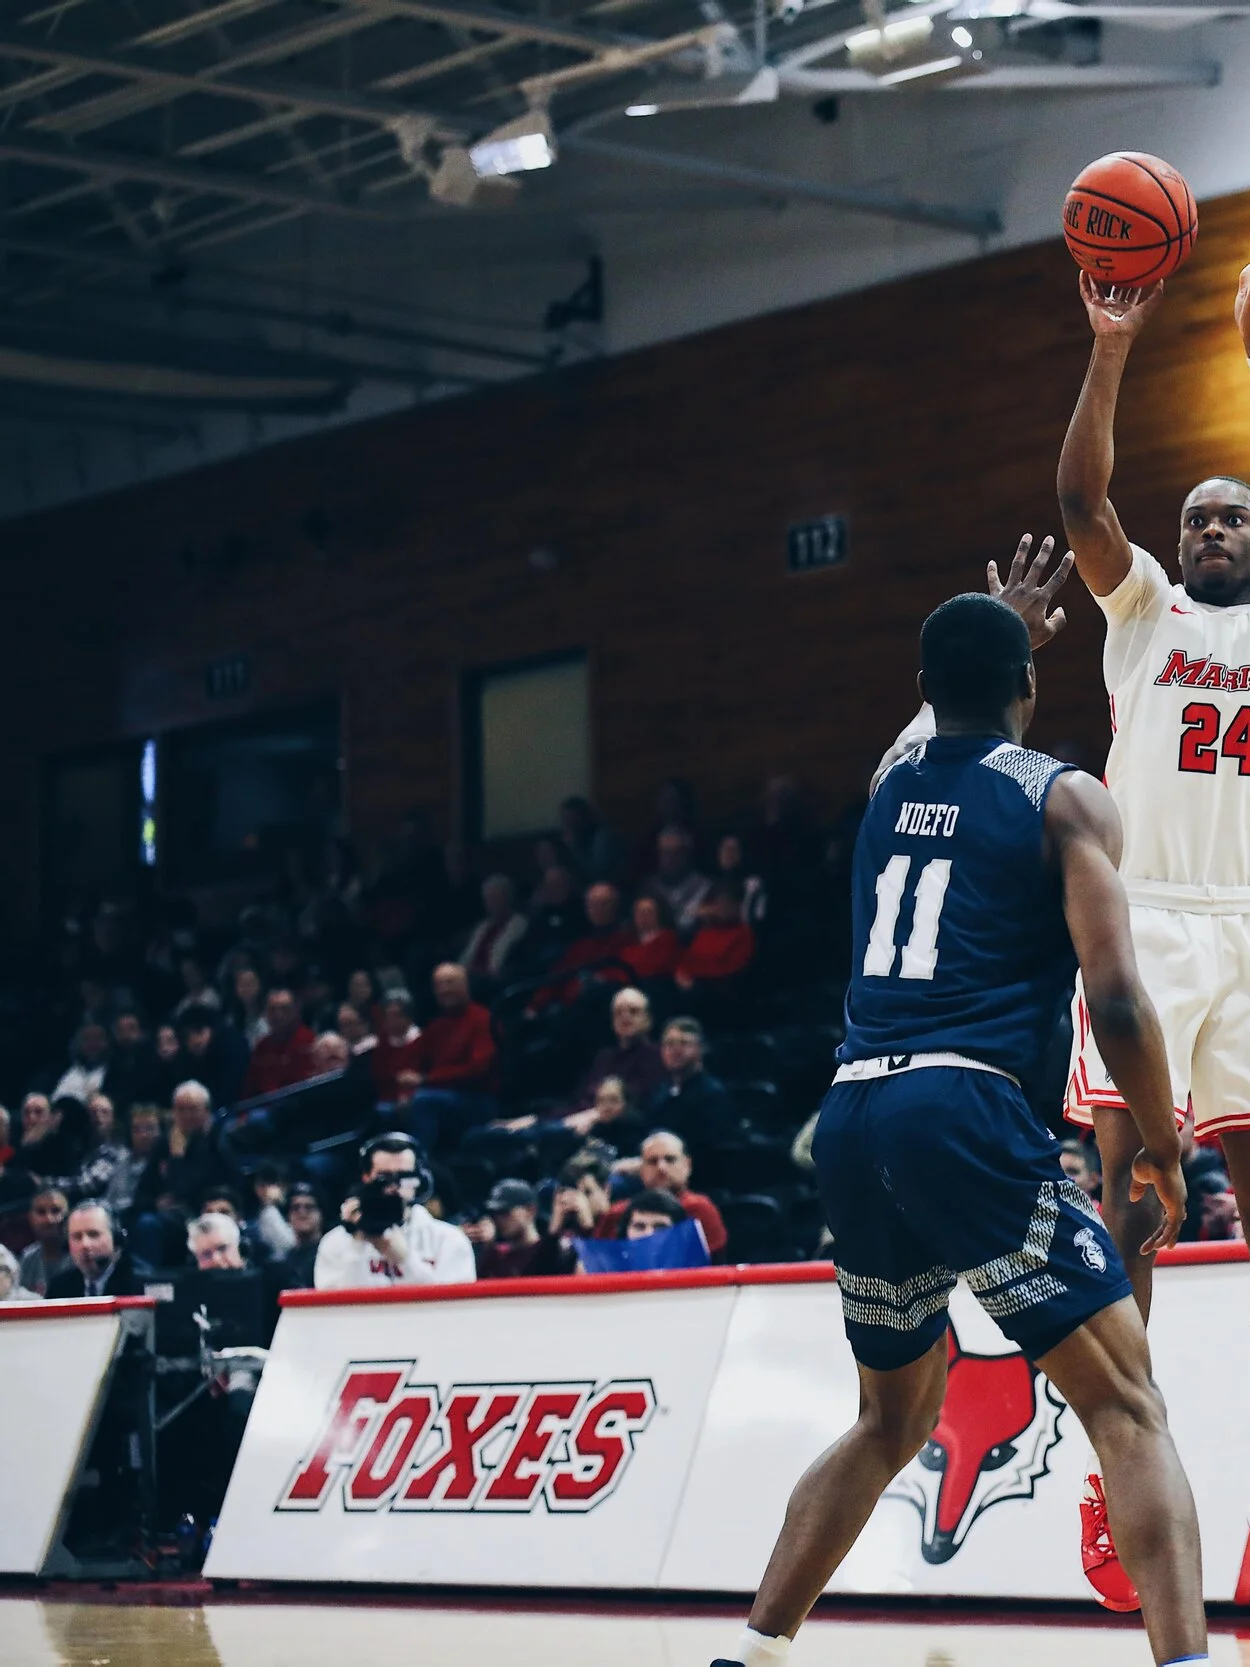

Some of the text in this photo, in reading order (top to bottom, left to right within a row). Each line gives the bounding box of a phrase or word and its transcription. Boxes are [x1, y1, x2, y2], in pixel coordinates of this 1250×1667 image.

[1087, 206, 1131, 240] ROCK
[894, 802, 960, 837] NDEFO
[863, 854, 953, 980] 11
[273, 1358, 657, 1513] FOXES
